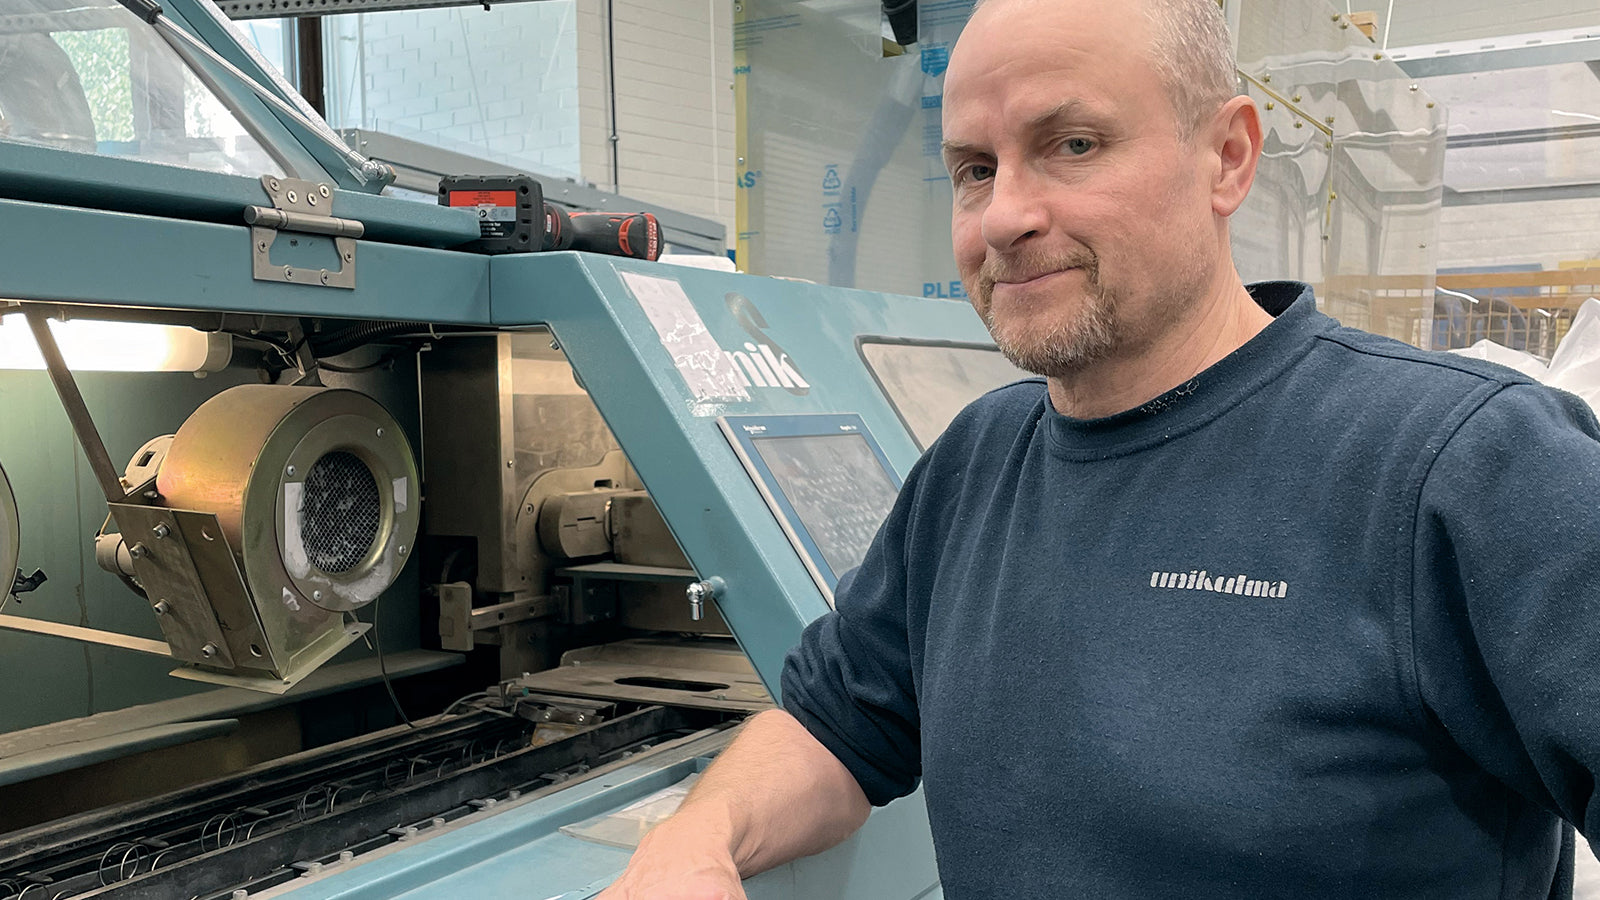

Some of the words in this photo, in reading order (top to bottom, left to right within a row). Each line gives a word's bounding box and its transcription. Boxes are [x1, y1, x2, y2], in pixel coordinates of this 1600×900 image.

[923, 281, 968, 299] PLE
[722, 342, 811, 388] nik
[1150, 570, 1288, 598] unikulma
